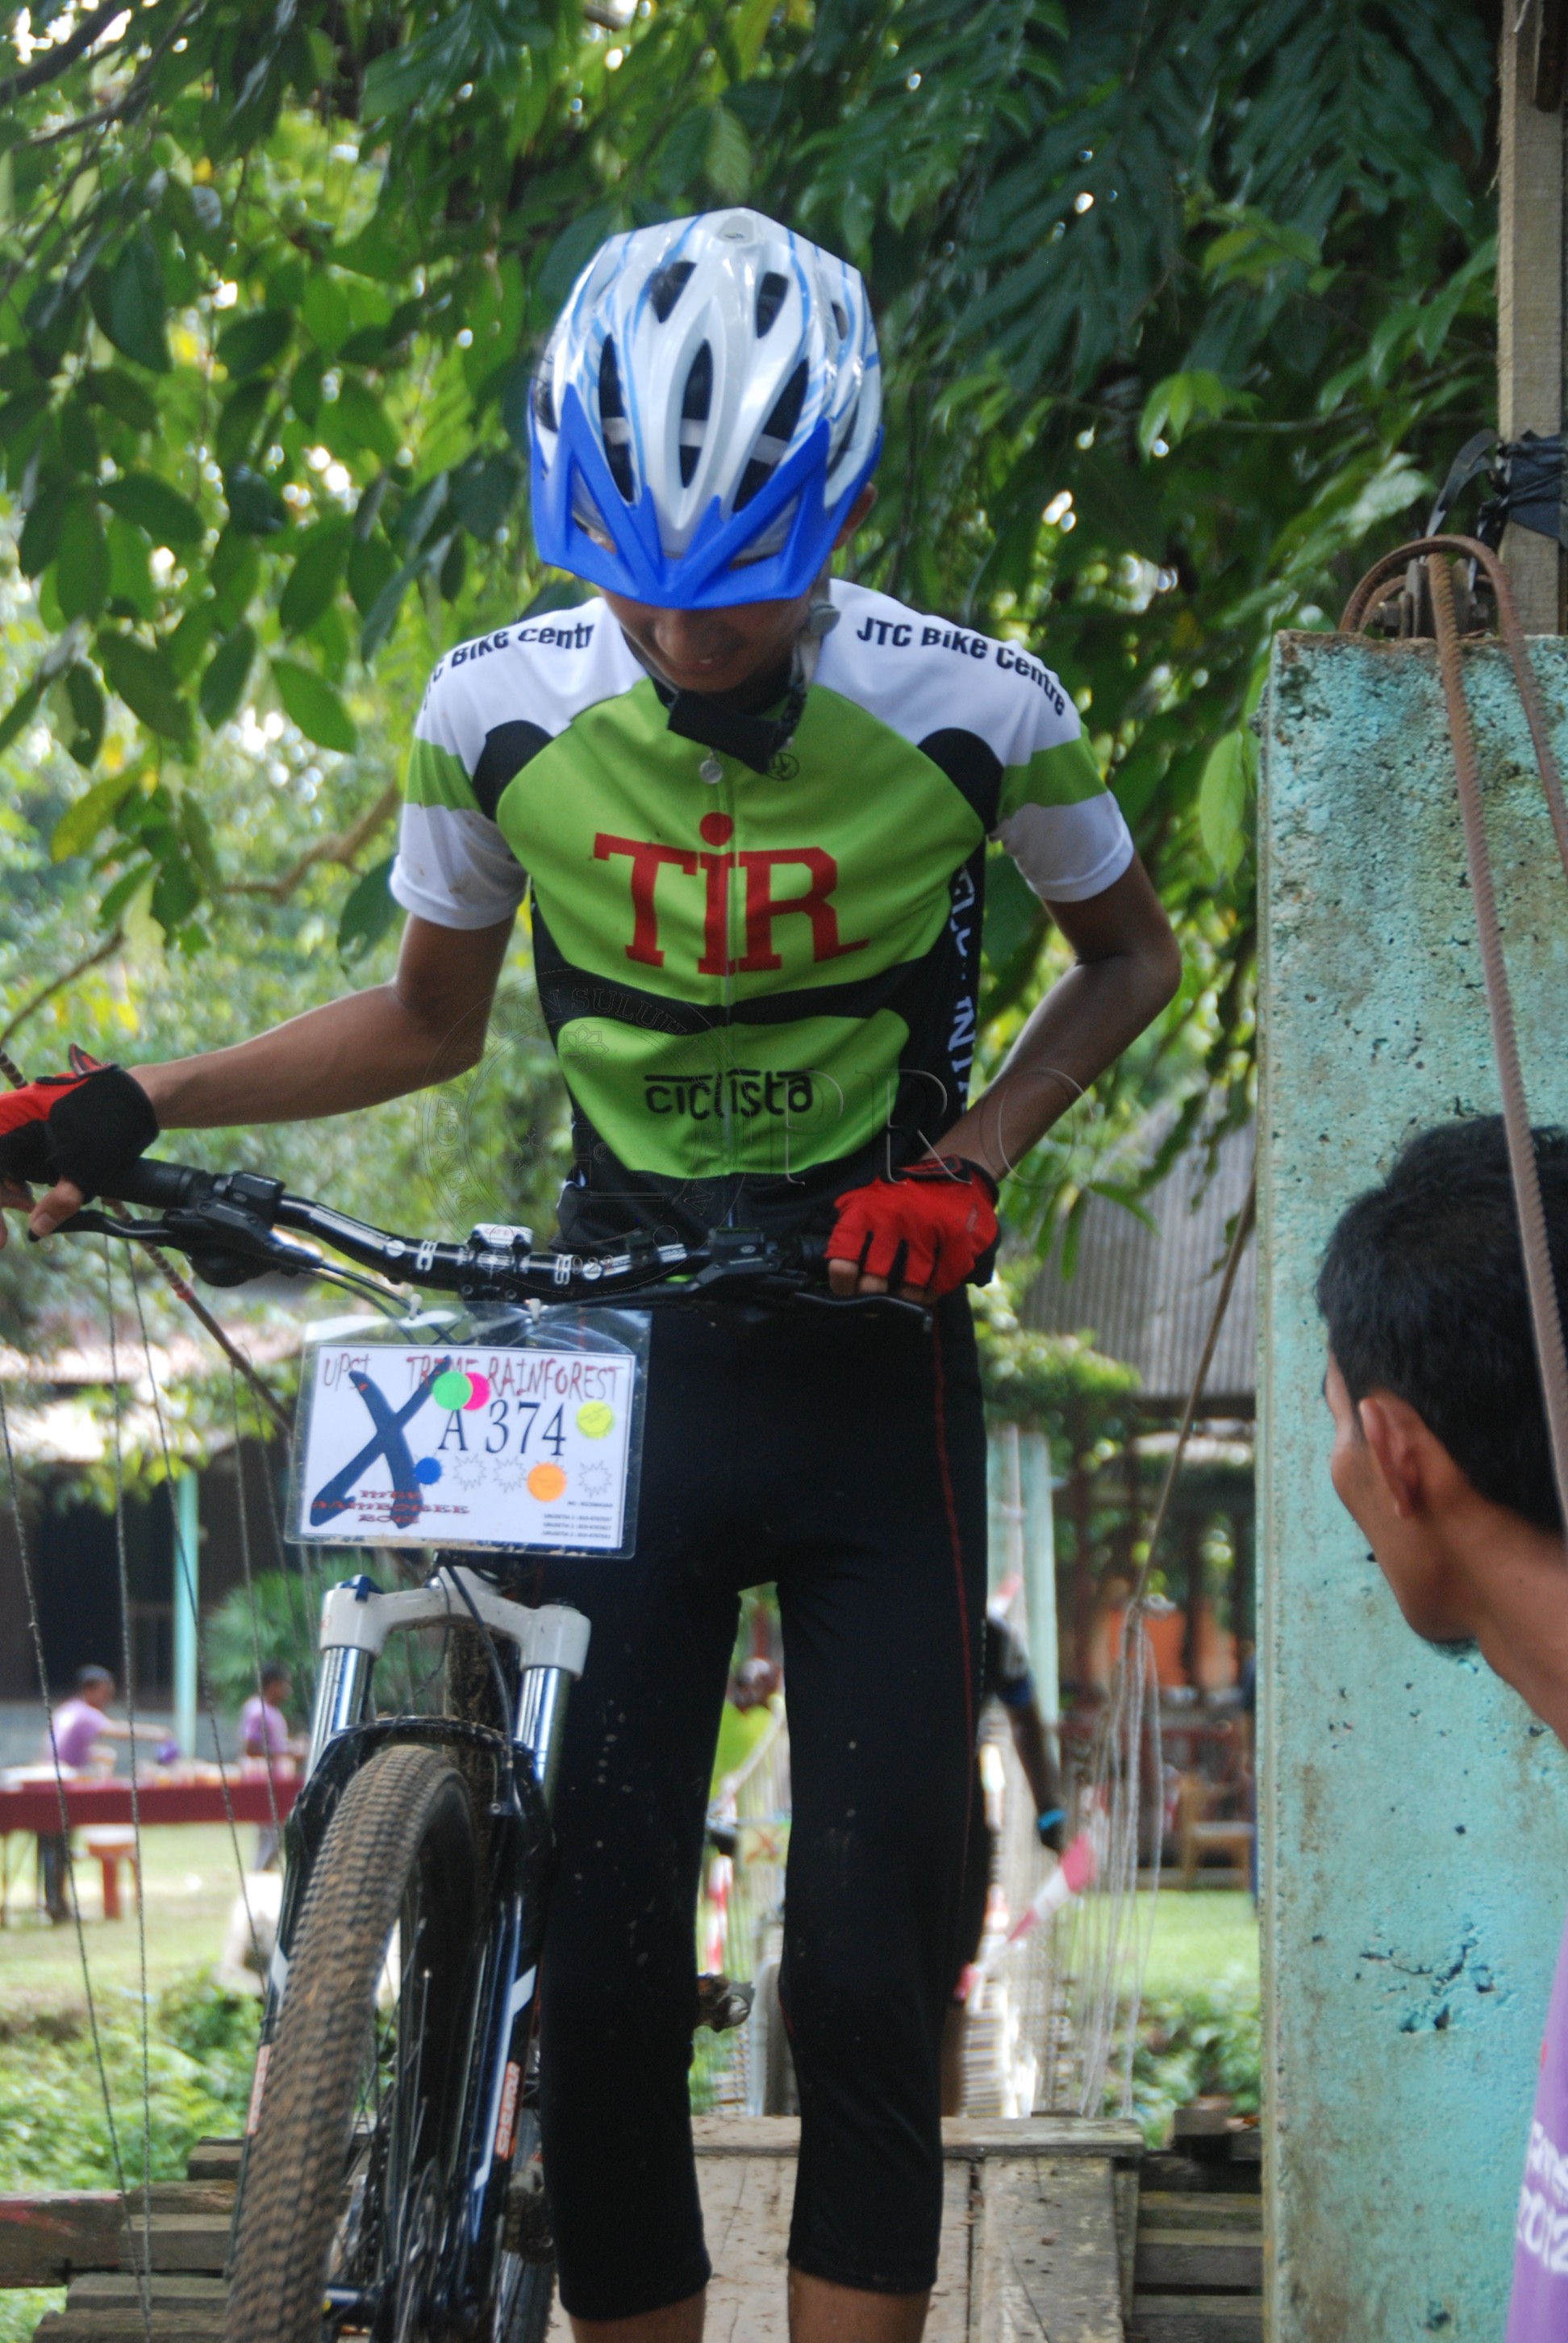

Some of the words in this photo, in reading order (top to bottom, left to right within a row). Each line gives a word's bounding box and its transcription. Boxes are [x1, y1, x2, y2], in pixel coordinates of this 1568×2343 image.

[857, 616, 912, 647] JTC
[487, 1355, 625, 1401] RAINFOREST
[438, 1409, 468, 1452] A
[486, 1399, 568, 1456] 374
